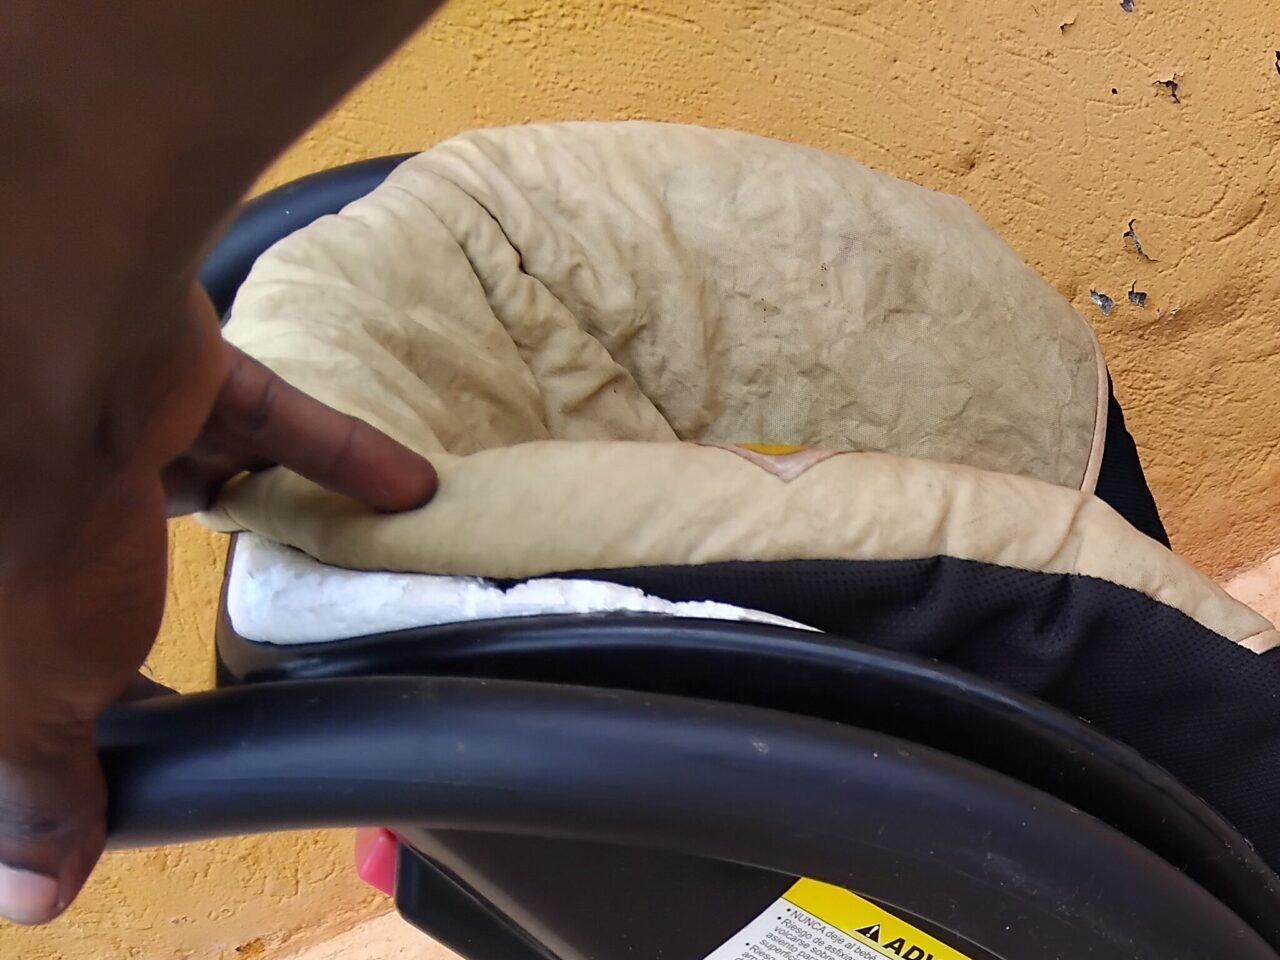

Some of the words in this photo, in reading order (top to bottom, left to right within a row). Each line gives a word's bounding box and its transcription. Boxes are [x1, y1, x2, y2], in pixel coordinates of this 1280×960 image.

[773, 927, 810, 949] volcarse
[781, 919, 813, 939] Riesgo
[790, 911, 827, 933] NUNCA
[824, 930, 845, 944] deje
[854, 947, 878, 960] bebé
[765, 933, 798, 953] asiento
